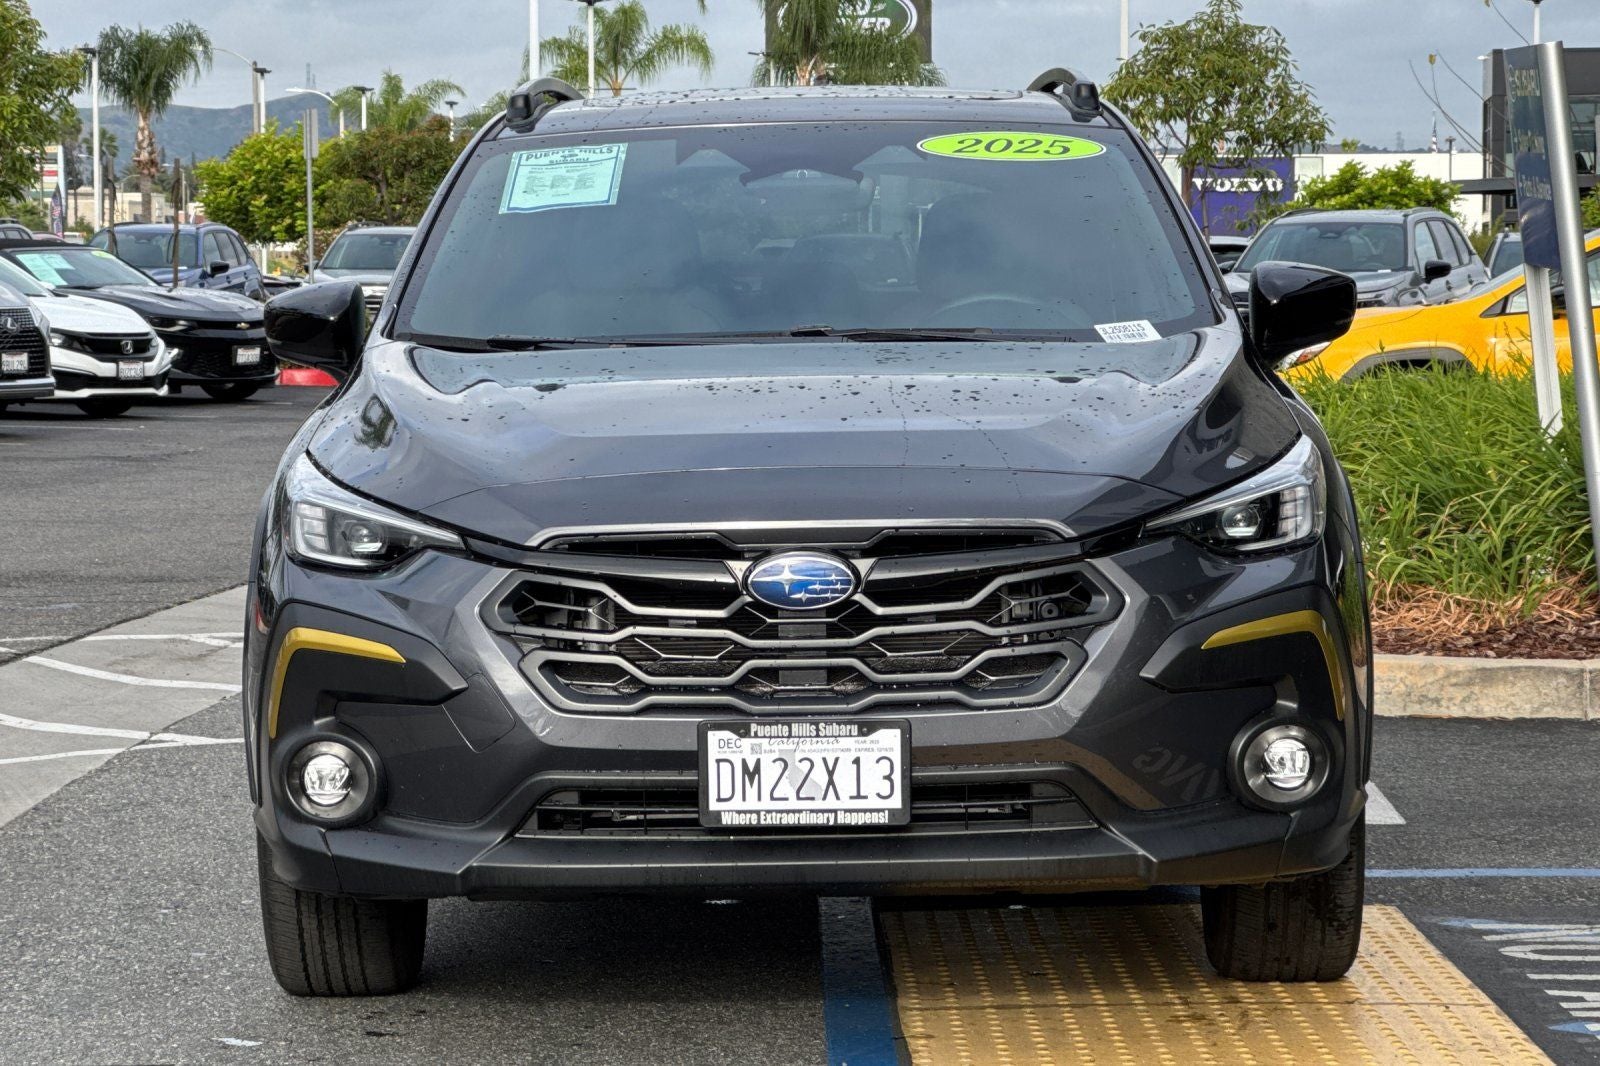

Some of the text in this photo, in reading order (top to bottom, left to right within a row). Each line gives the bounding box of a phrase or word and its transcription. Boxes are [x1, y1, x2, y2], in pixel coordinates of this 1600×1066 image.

[525, 146, 613, 161] PUENTE HILLS
[952, 138, 1073, 156] 2025
[1192, 177, 1284, 192] VOLVO
[750, 723, 858, 737] Puente Hills Subaru
[718, 738, 742, 749] DEC
[715, 756, 895, 802] DM22X13
[721, 810, 889, 825] Where Extraordinary Happens!
